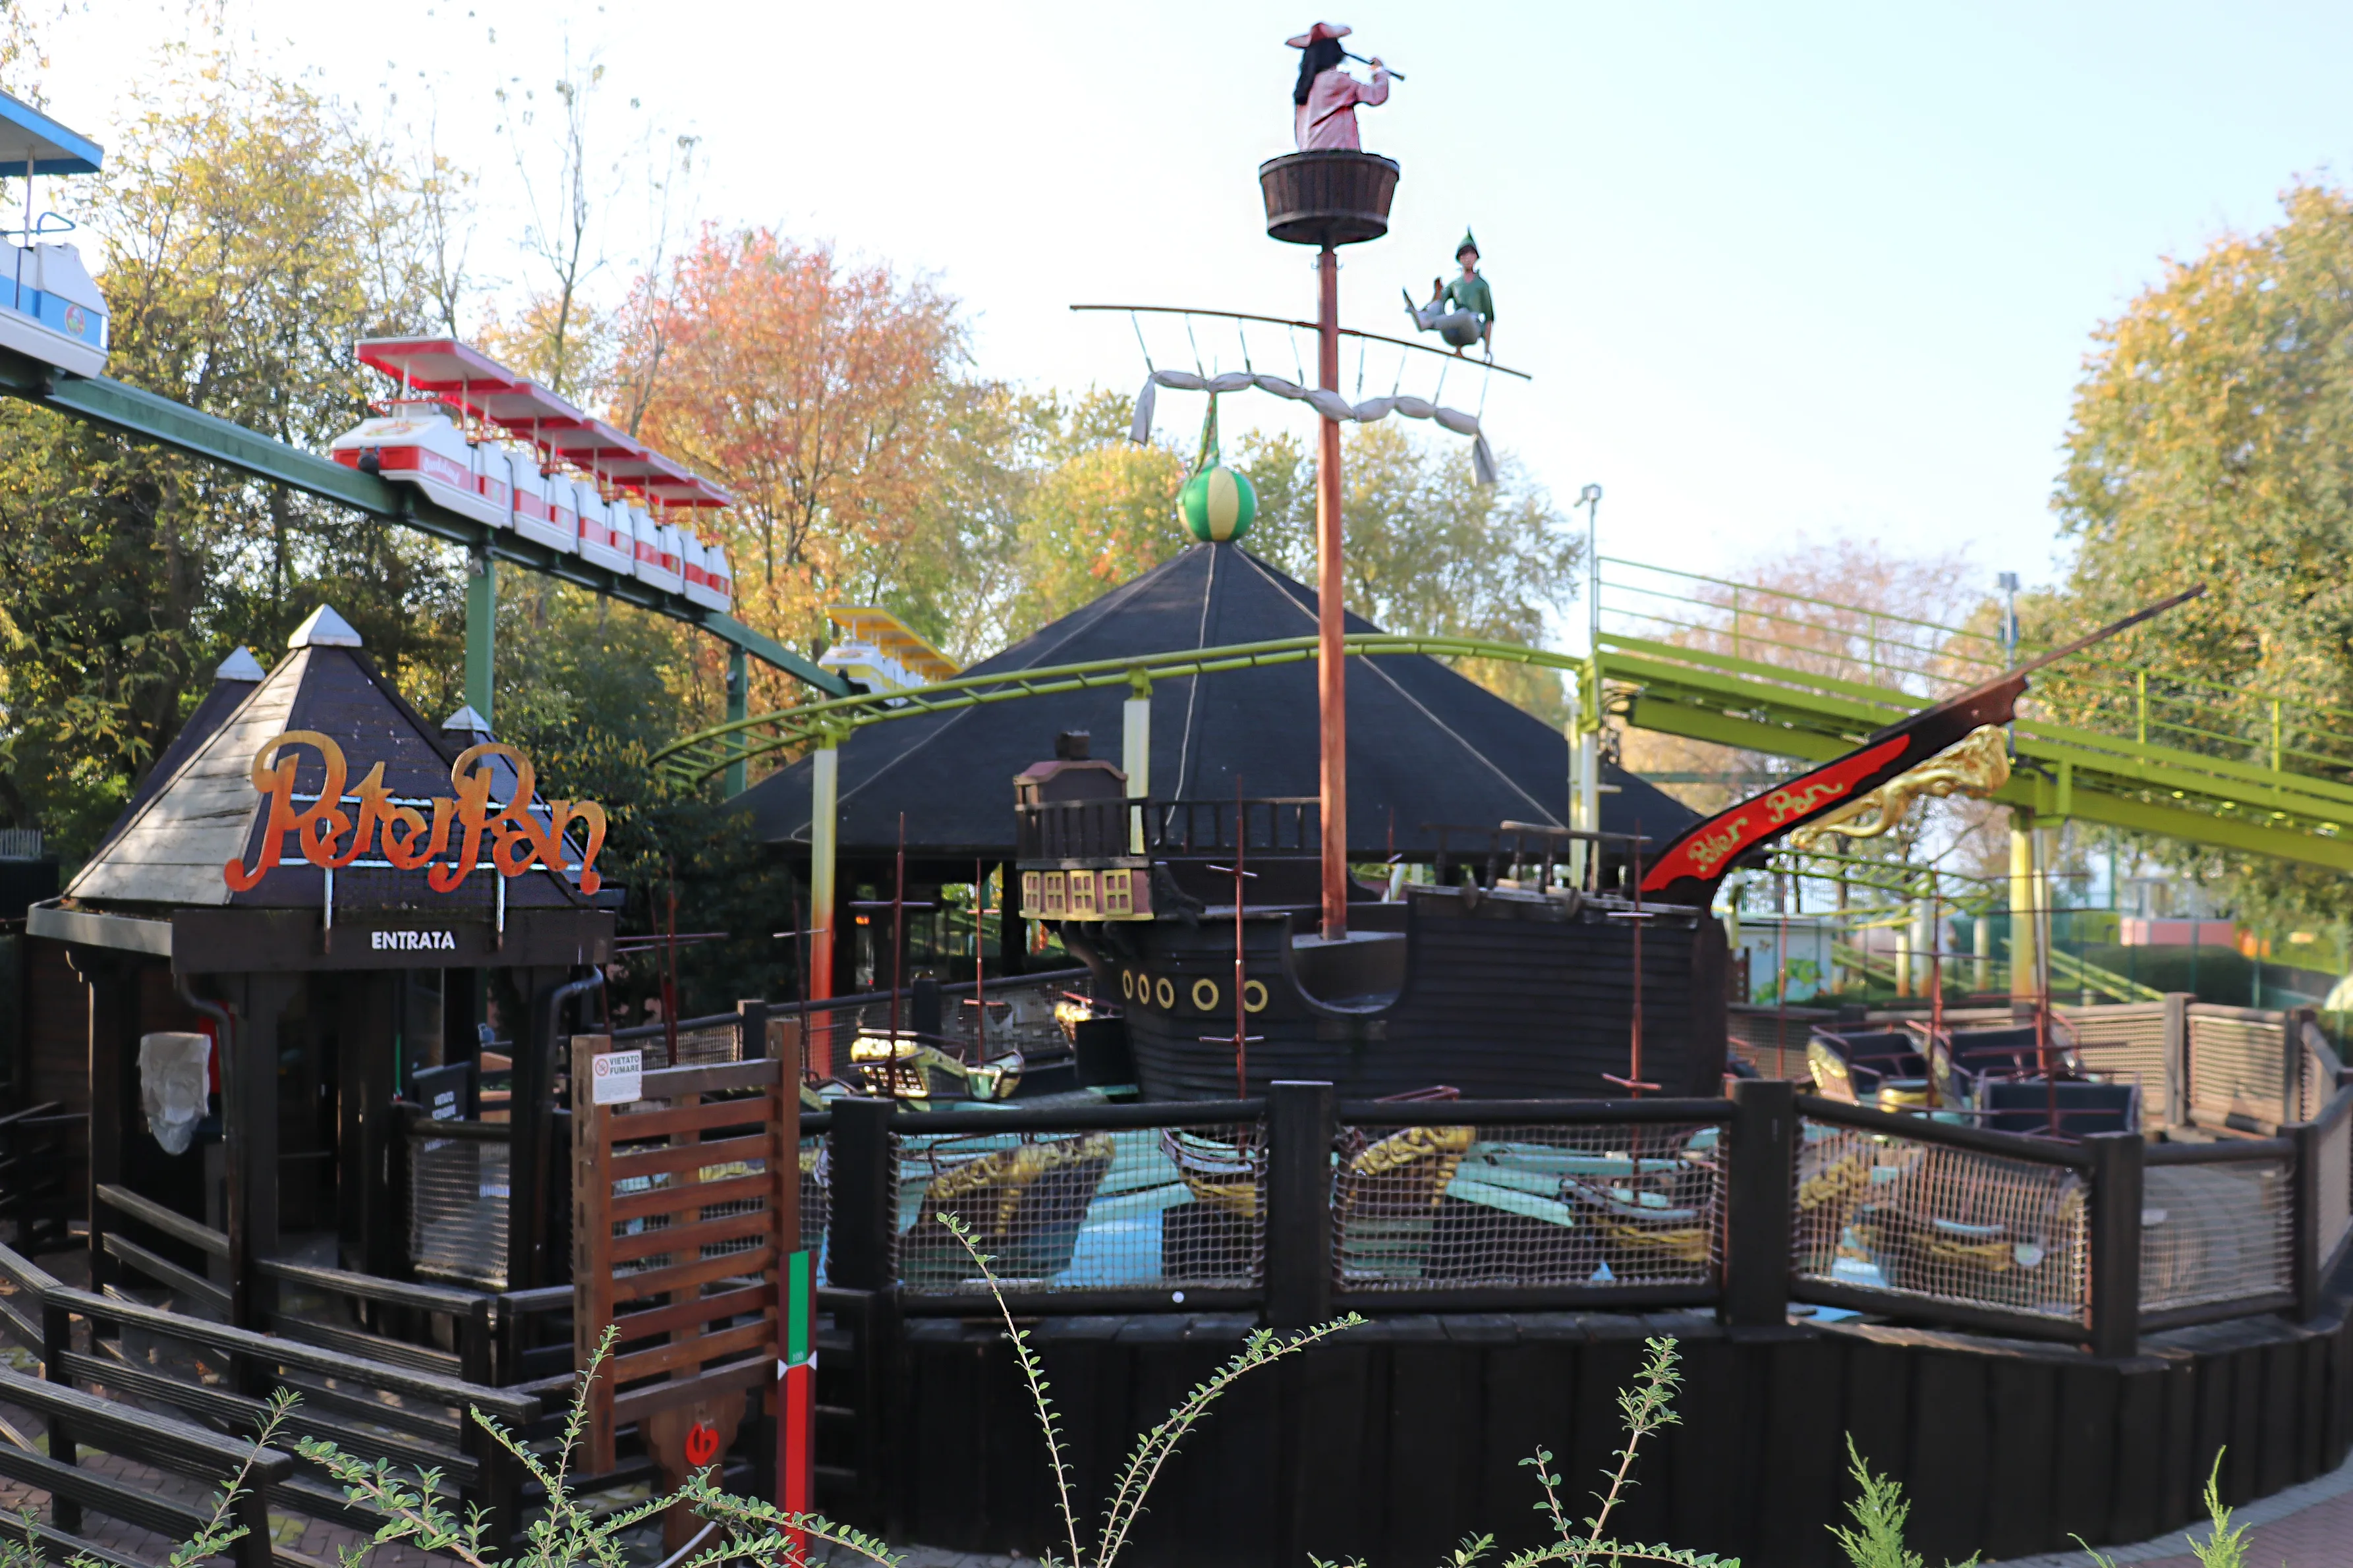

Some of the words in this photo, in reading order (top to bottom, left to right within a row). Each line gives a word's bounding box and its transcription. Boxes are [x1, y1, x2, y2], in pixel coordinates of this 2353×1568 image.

[223, 730, 459, 891] Peter
[428, 742, 606, 895] Pan
[1765, 783, 1843, 823] Pan
[371, 930, 456, 951] ENTRATA
[609, 1055, 639, 1065] VIETATO
[610, 1065, 640, 1075] FUMARE
